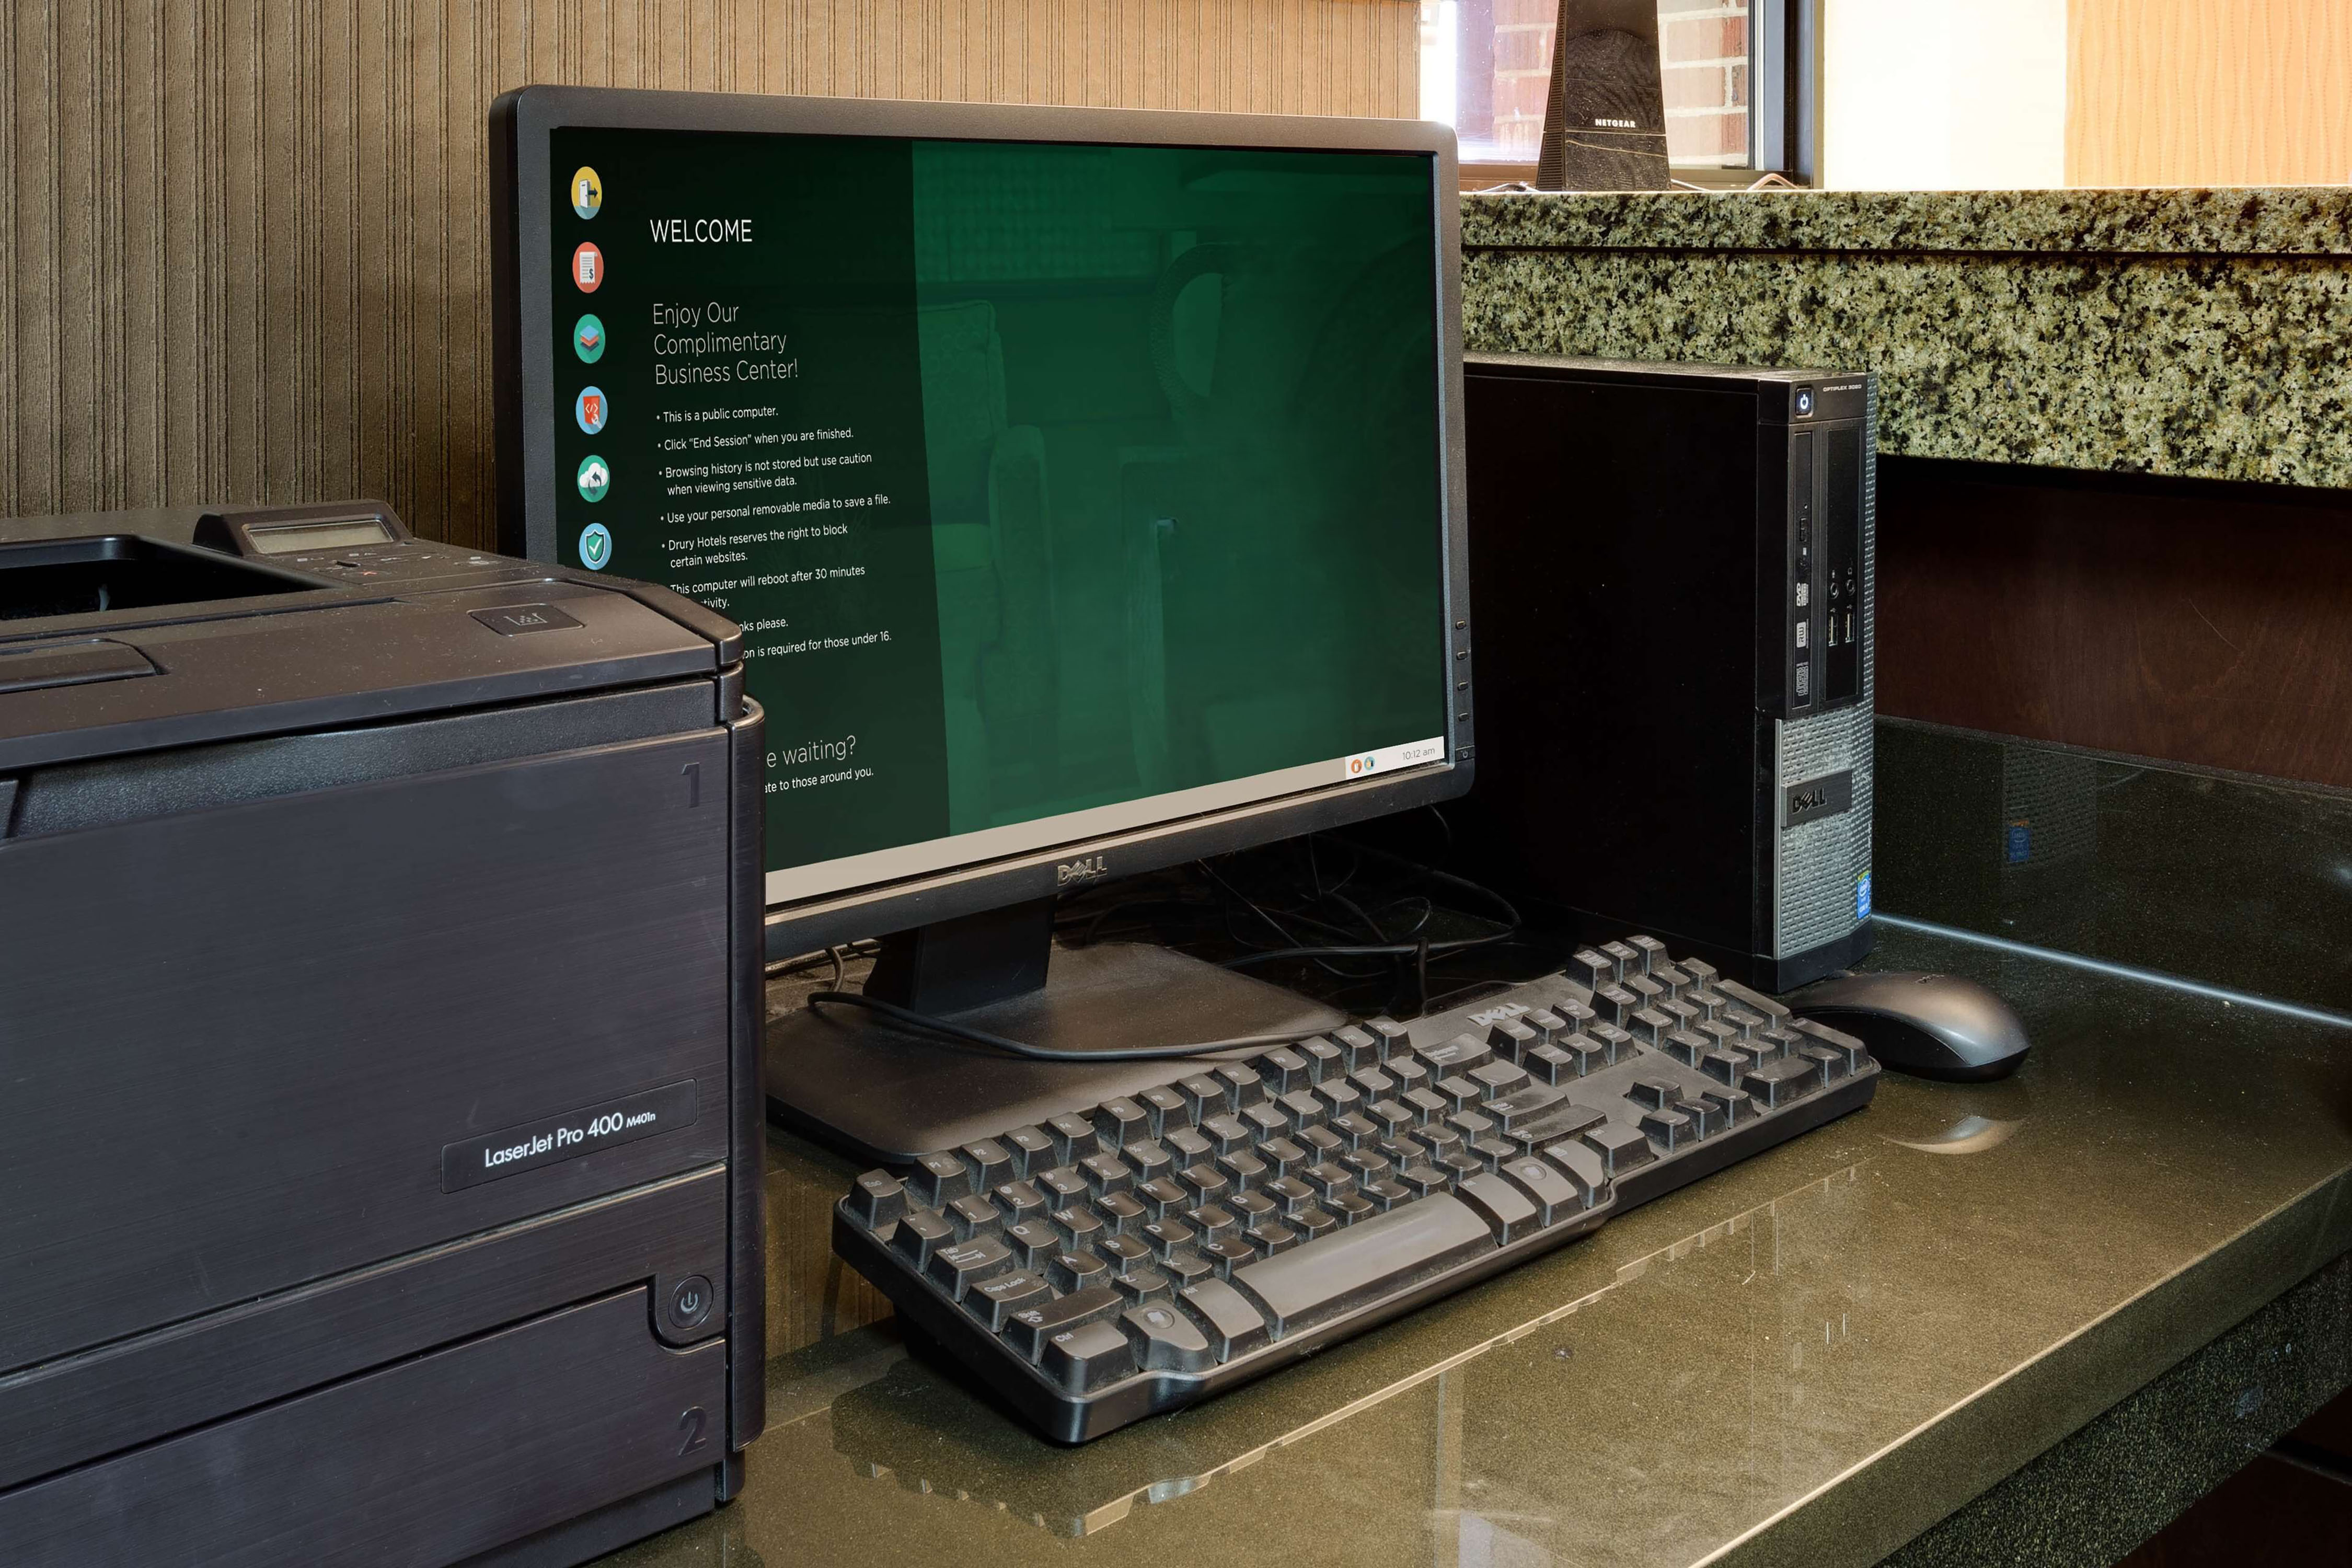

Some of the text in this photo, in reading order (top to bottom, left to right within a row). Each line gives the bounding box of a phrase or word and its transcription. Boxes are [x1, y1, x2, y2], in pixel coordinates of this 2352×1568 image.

[1595, 119, 1635, 128] NETGEAR
[650, 219, 753, 243] WELCOME
[653, 302, 739, 328] Enjoy Our
[654, 331, 787, 357] Complimentary
[655, 358, 798, 385] Business Center!
[663, 406, 778, 423] This is a public computer.
[664, 438, 687, 451] Click
[754, 433, 779, 444] when
[781, 433, 798, 445] you
[800, 432, 815, 441] are
[816, 427, 854, 440] finished.
[665, 453, 872, 478] Browsing history is not stored but use caution
[667, 476, 797, 495] when viewing sensitive data.
[667, 493, 891, 524] Use your personal removable media to save a file.
[668, 523, 848, 551] Drury Hotels reserves the right to block
[670, 551, 748, 568] certain websites.
[692, 579, 737, 593] computer
[740, 575, 755, 587] will
[758, 573, 789, 585] reboot
[791, 570, 813, 582] after
[815, 568, 827, 580] 30
[829, 566, 866, 578] minutes
[756, 618, 789, 632] please.
[757, 646, 765, 657] is
[767, 640, 806, 656] required
[808, 639, 822, 650] for
[824, 637, 849, 649] those
[851, 632, 878, 645] under
[880, 630, 892, 641] 16.
[782, 735, 856, 765] waiting?
[1403, 750, 1421, 760] 10:12
[682, 763, 699, 808] 1
[779, 780, 790, 791] to
[791, 776, 817, 789] those
[820, 768, 852, 784] around
[854, 767, 874, 780] you.
[1793, 788, 1827, 815] DELL
[1058, 856, 1107, 886] DELL
[1467, 1002, 1531, 1027] DELL
[485, 1134, 552, 1167] LaserJet
[557, 1127, 583, 1147] Pro
[587, 1113, 622, 1138] 400
[679, 1406, 707, 1456] 2
